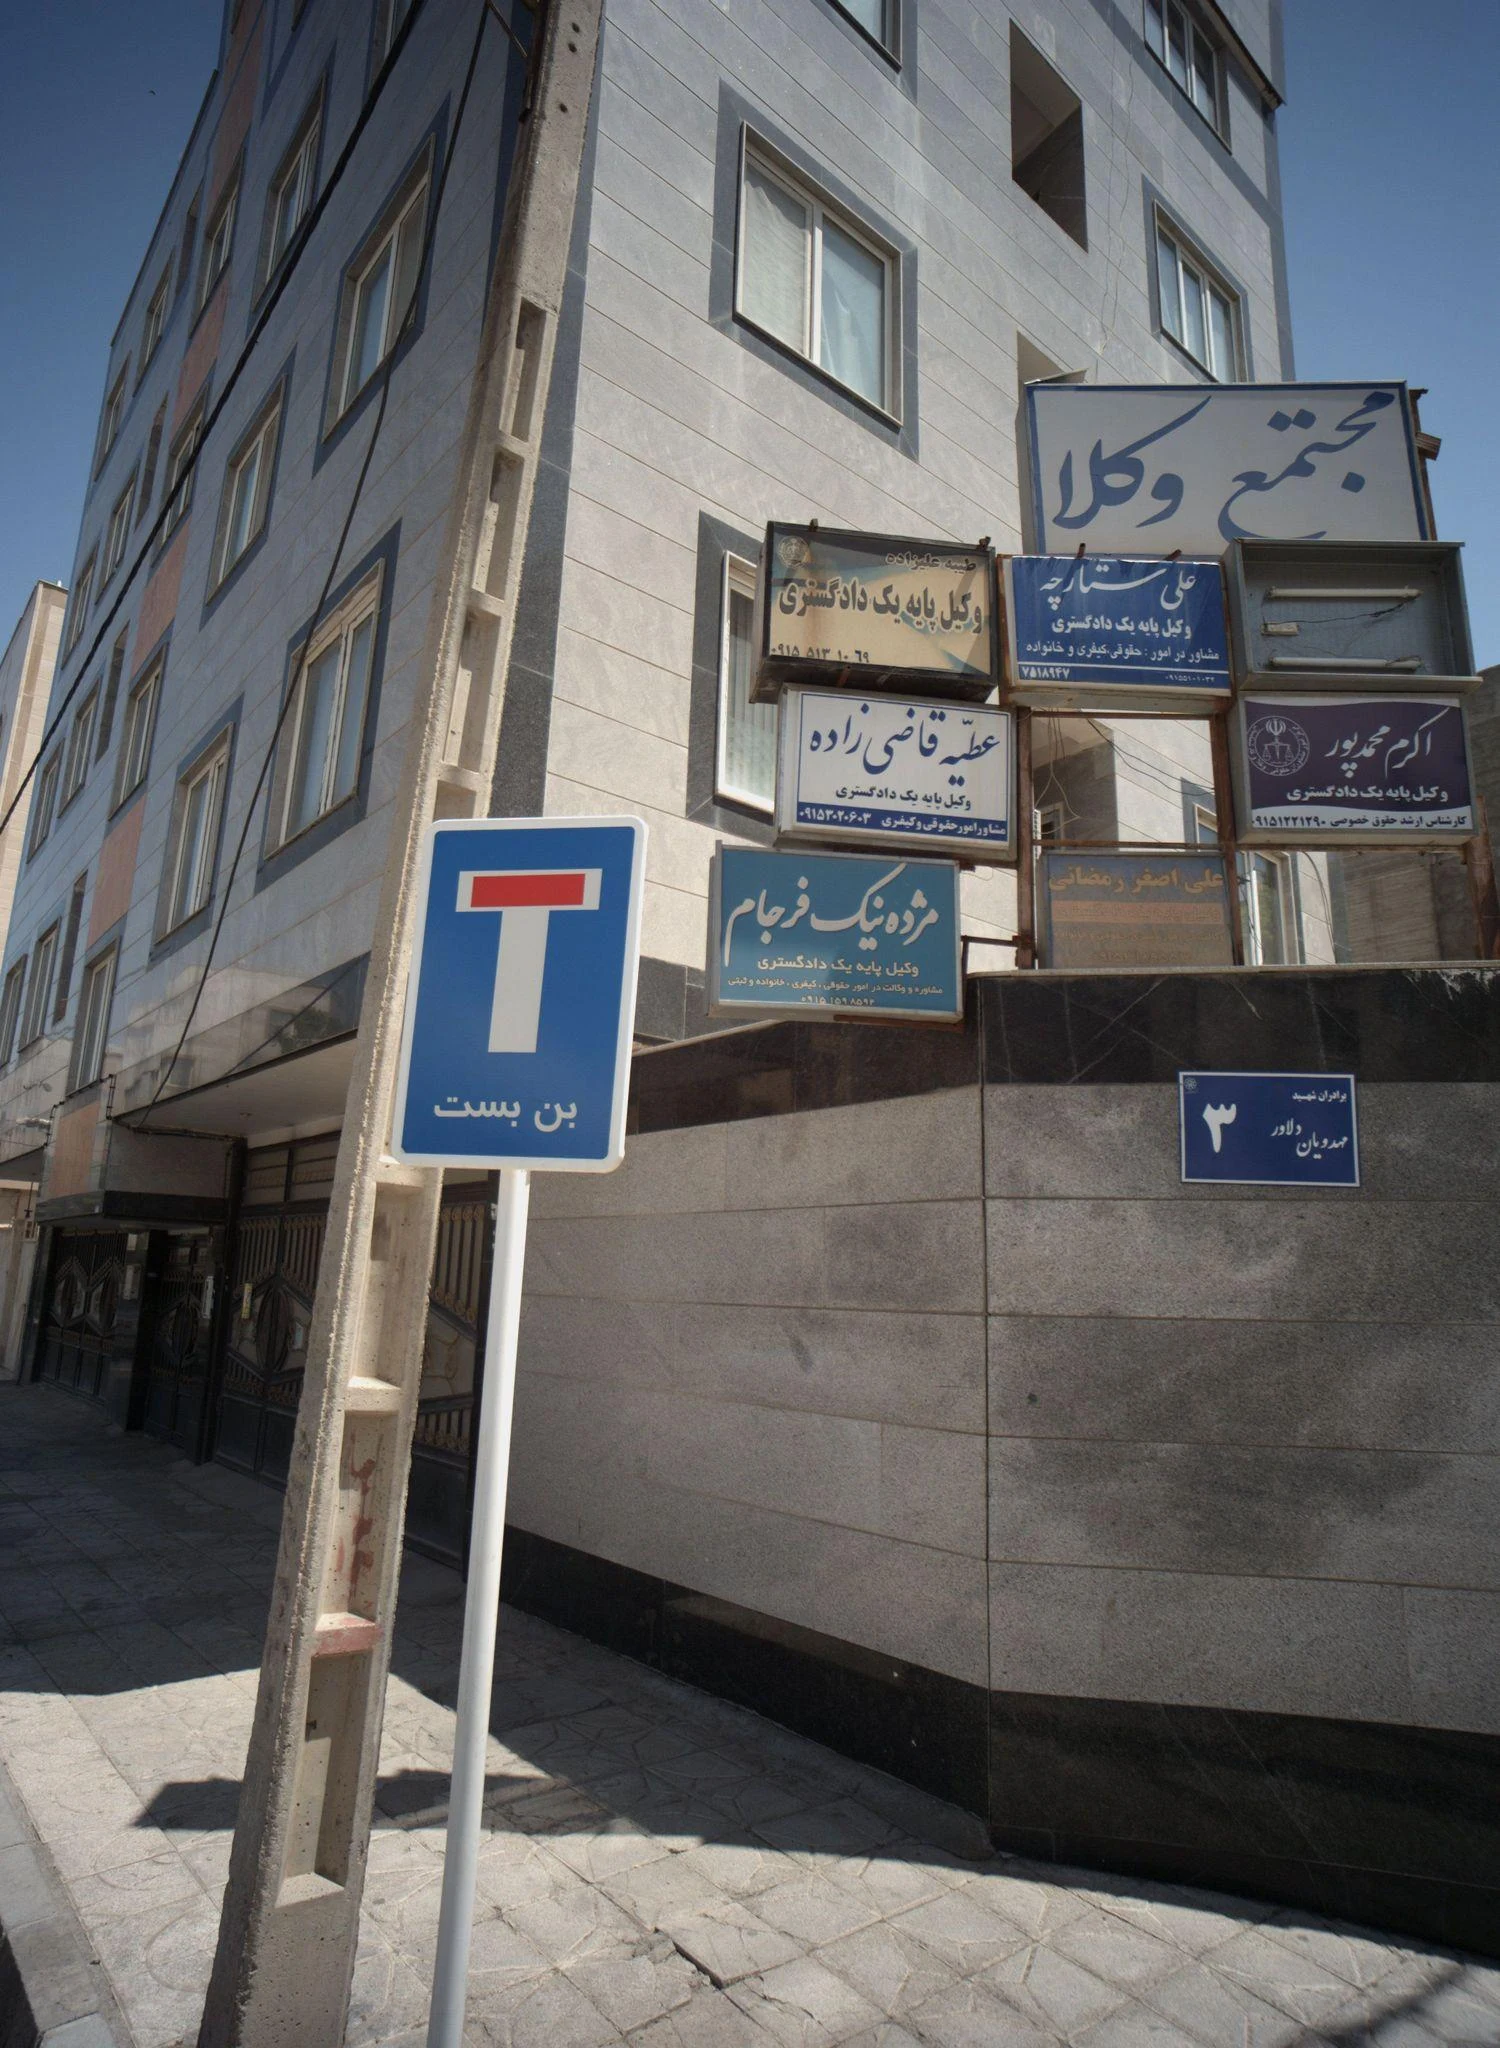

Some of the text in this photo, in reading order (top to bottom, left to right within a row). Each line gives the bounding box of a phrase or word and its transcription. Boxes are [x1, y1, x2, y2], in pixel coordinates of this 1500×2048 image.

[1052, 391, 1395, 540] مجتمع وکلا
[1160, 570, 1197, 610] علی
[779, 578, 982, 634] وکیل پایه یک دادگستری
[1052, 615, 1192, 639] وکیل پایه یک دادگستری
[1026, 640, 1064, 656] خانواده
[1067, 645, 1075, 657] و
[1151, 646, 1171, 661] امور
[1174, 650, 1186, 662] در
[1188, 648, 1219, 663] مشاور
[810, 703, 870, 755] زاده
[863, 707, 946, 775] قاضی
[1385, 707, 1450, 779] اکرم
[835, 786, 972, 810] وکیل پایه یک دادگستری
[1286, 785, 1448, 802] وکیل پایه یک دادگستری
[882, 815, 916, 828] کیفری
[923, 817, 958, 832] حقوقی
[957, 822, 977, 834] امور
[1330, 815, 1467, 827] کارشناس ارشد حقوق خصوصی
[978, 823, 1006, 836] مشاور
[1049, 865, 1224, 895] علی اصغر رمضانی
[724, 863, 939, 967] مژده نیک فرجام
[757, 955, 919, 977] وکیل پایه یک دادگستری
[756, 978, 785, 988] خانواده
[852, 983, 868, 992] امور
[871, 985, 881, 993] در
[882, 984, 906, 994] وکالت
[1292, 1090, 1347, 1102] برادران شهید
[433, 1096, 577, 1132] بن بست
[1202, 1103, 1237, 1153] ۳
[1270, 1117, 1349, 1159] مهدویان دلاور
